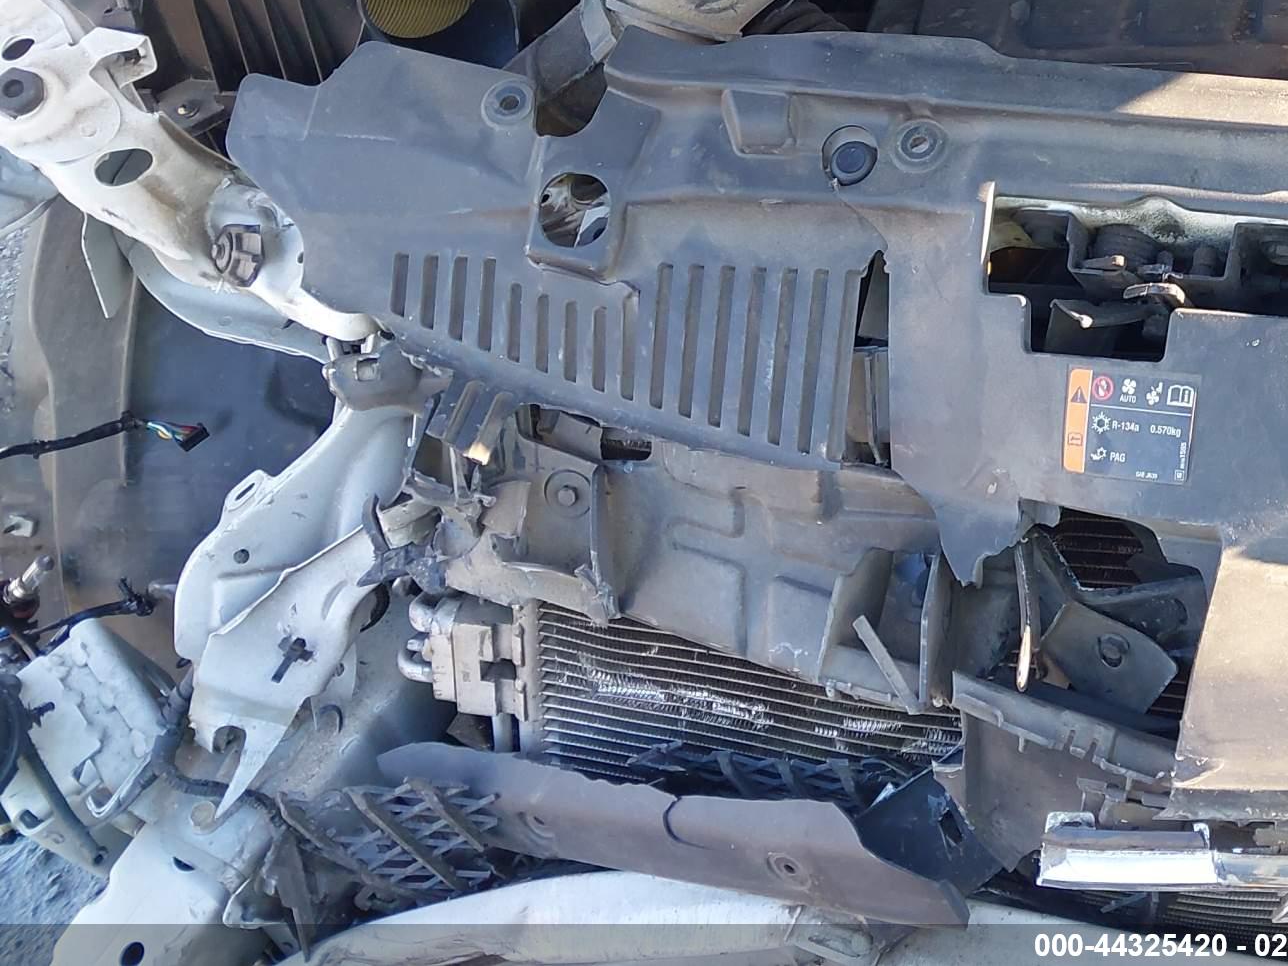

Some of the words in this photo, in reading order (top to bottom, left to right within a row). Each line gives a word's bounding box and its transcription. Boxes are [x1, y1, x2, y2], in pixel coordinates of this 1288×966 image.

[1120, 395, 1137, 403] AUTO
[1112, 421, 1140, 432] R-134a
[1150, 425, 1181, 438] 0.570kg
[1110, 452, 1126, 462] PAG
